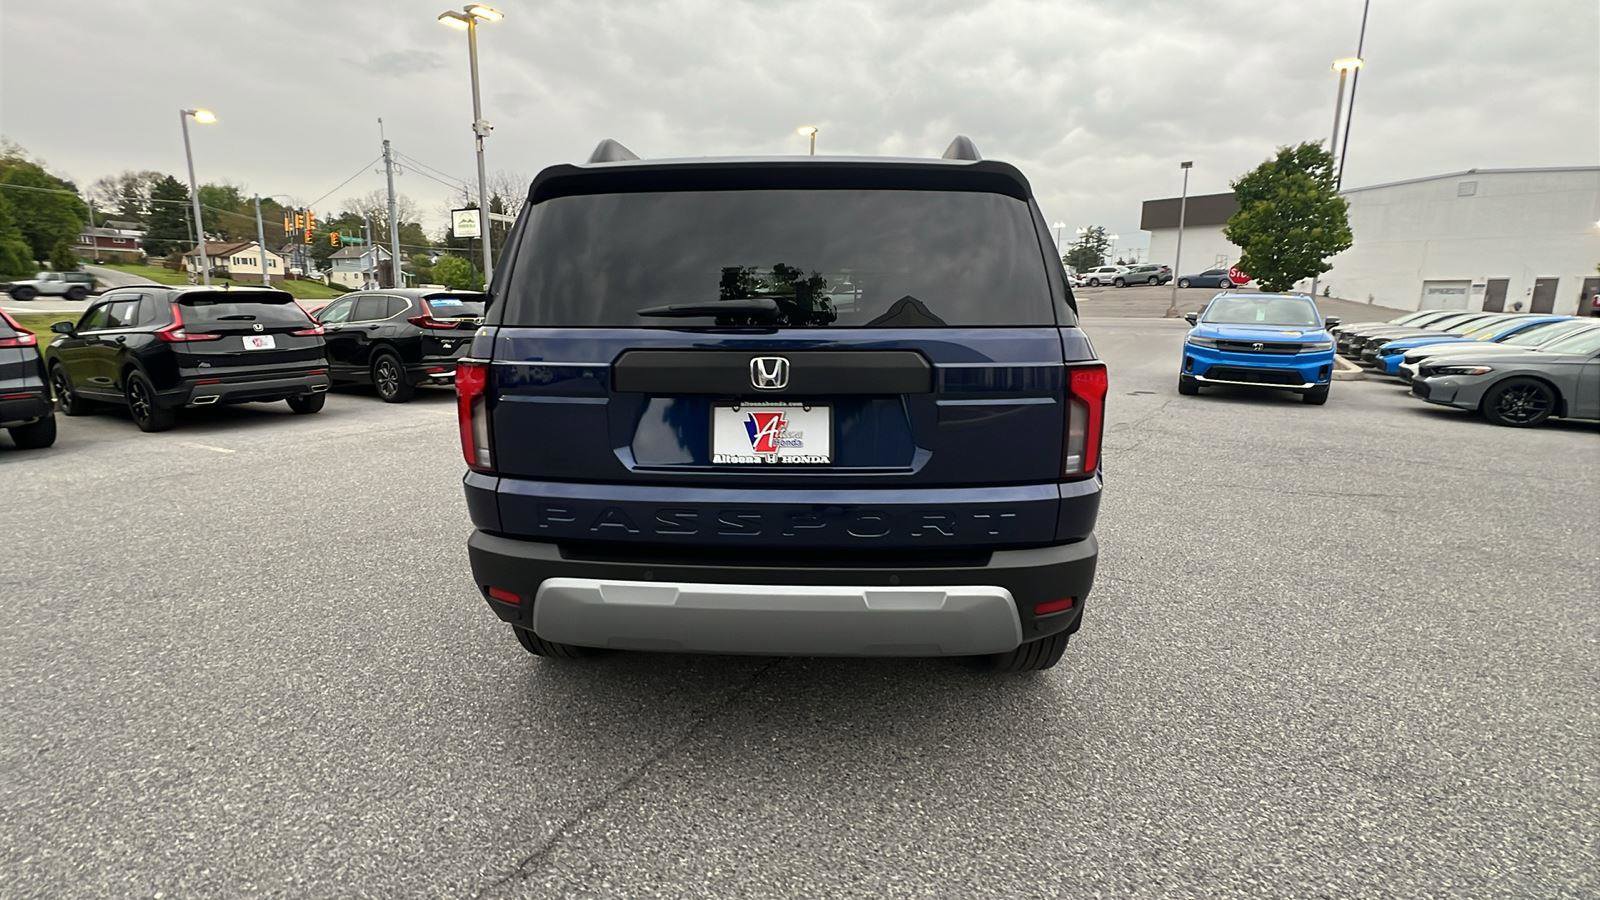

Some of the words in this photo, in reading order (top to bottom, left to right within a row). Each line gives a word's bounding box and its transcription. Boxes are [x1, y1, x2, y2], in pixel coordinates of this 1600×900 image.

[713, 454, 762, 463] Altoona
[781, 454, 830, 463] HONDA
[538, 504, 1017, 537] PASSPORT
